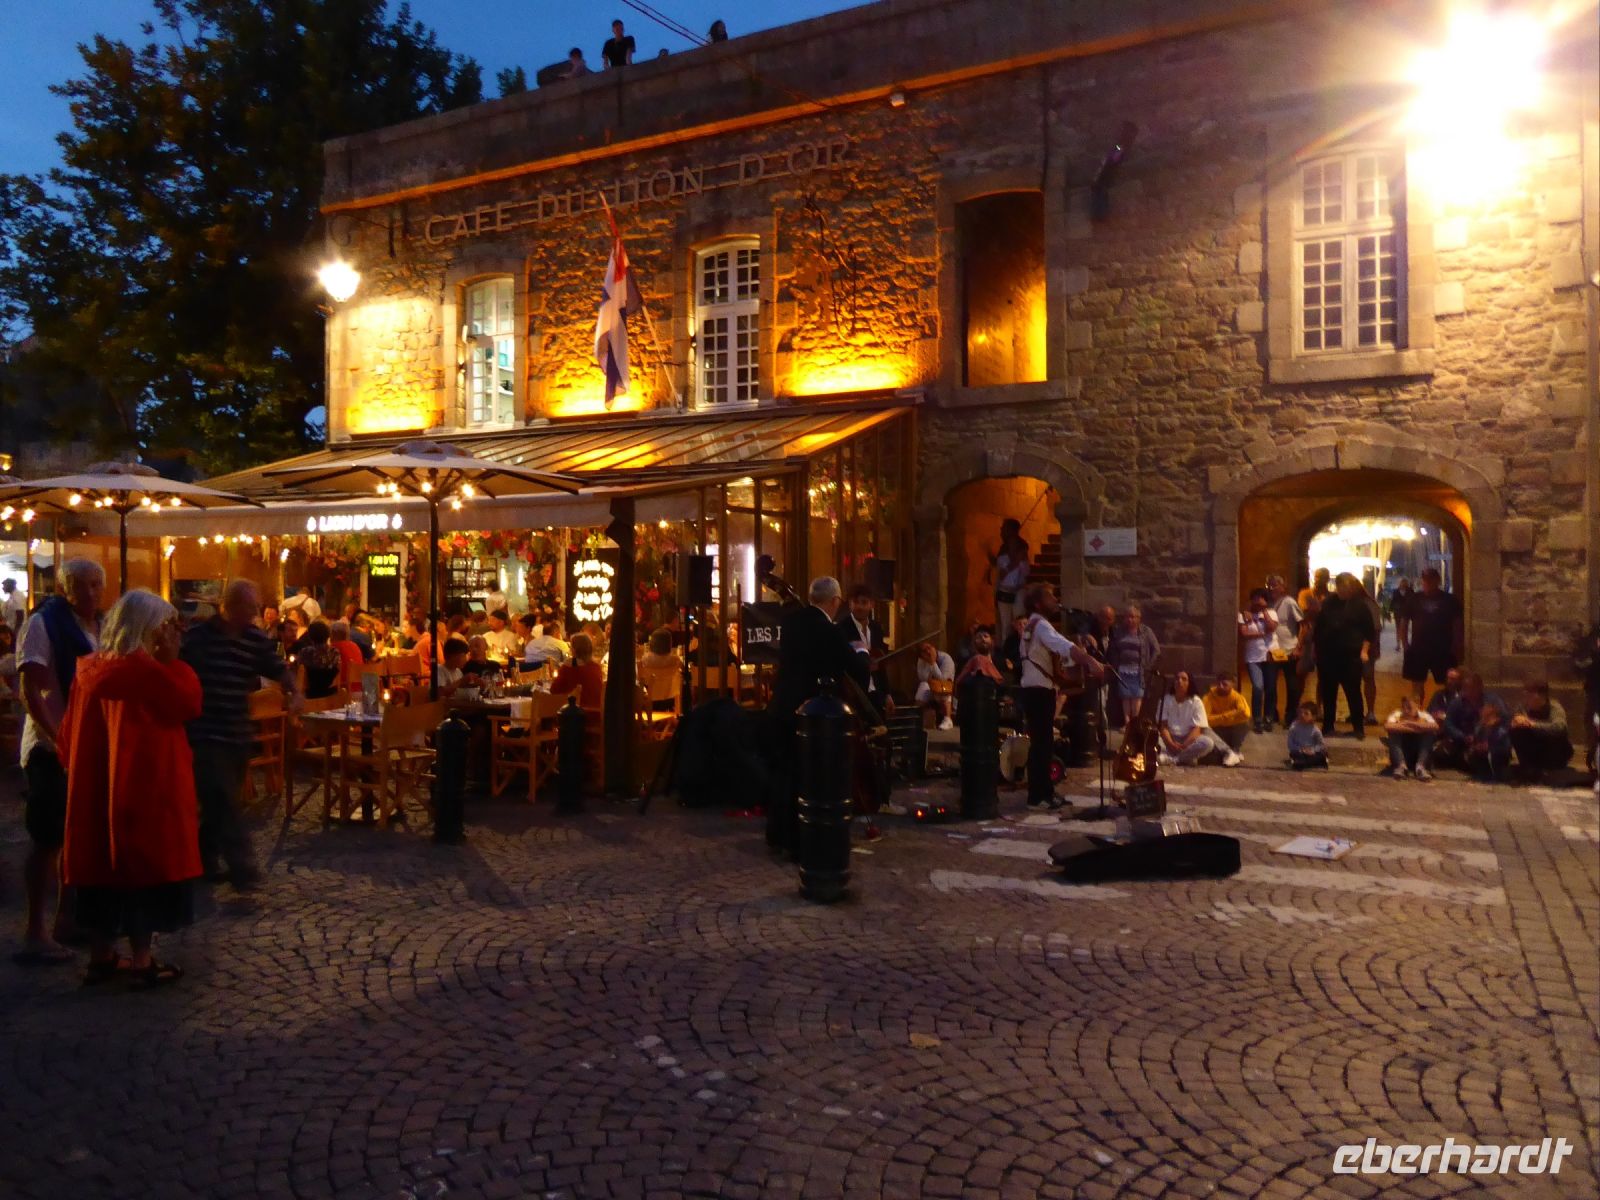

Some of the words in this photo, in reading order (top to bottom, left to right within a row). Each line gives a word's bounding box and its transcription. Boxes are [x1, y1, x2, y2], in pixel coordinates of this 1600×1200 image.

[537, 185, 586, 224] DU
[615, 163, 704, 209] LION
[319, 515, 353, 532] LION
[747, 627, 772, 643] LES
